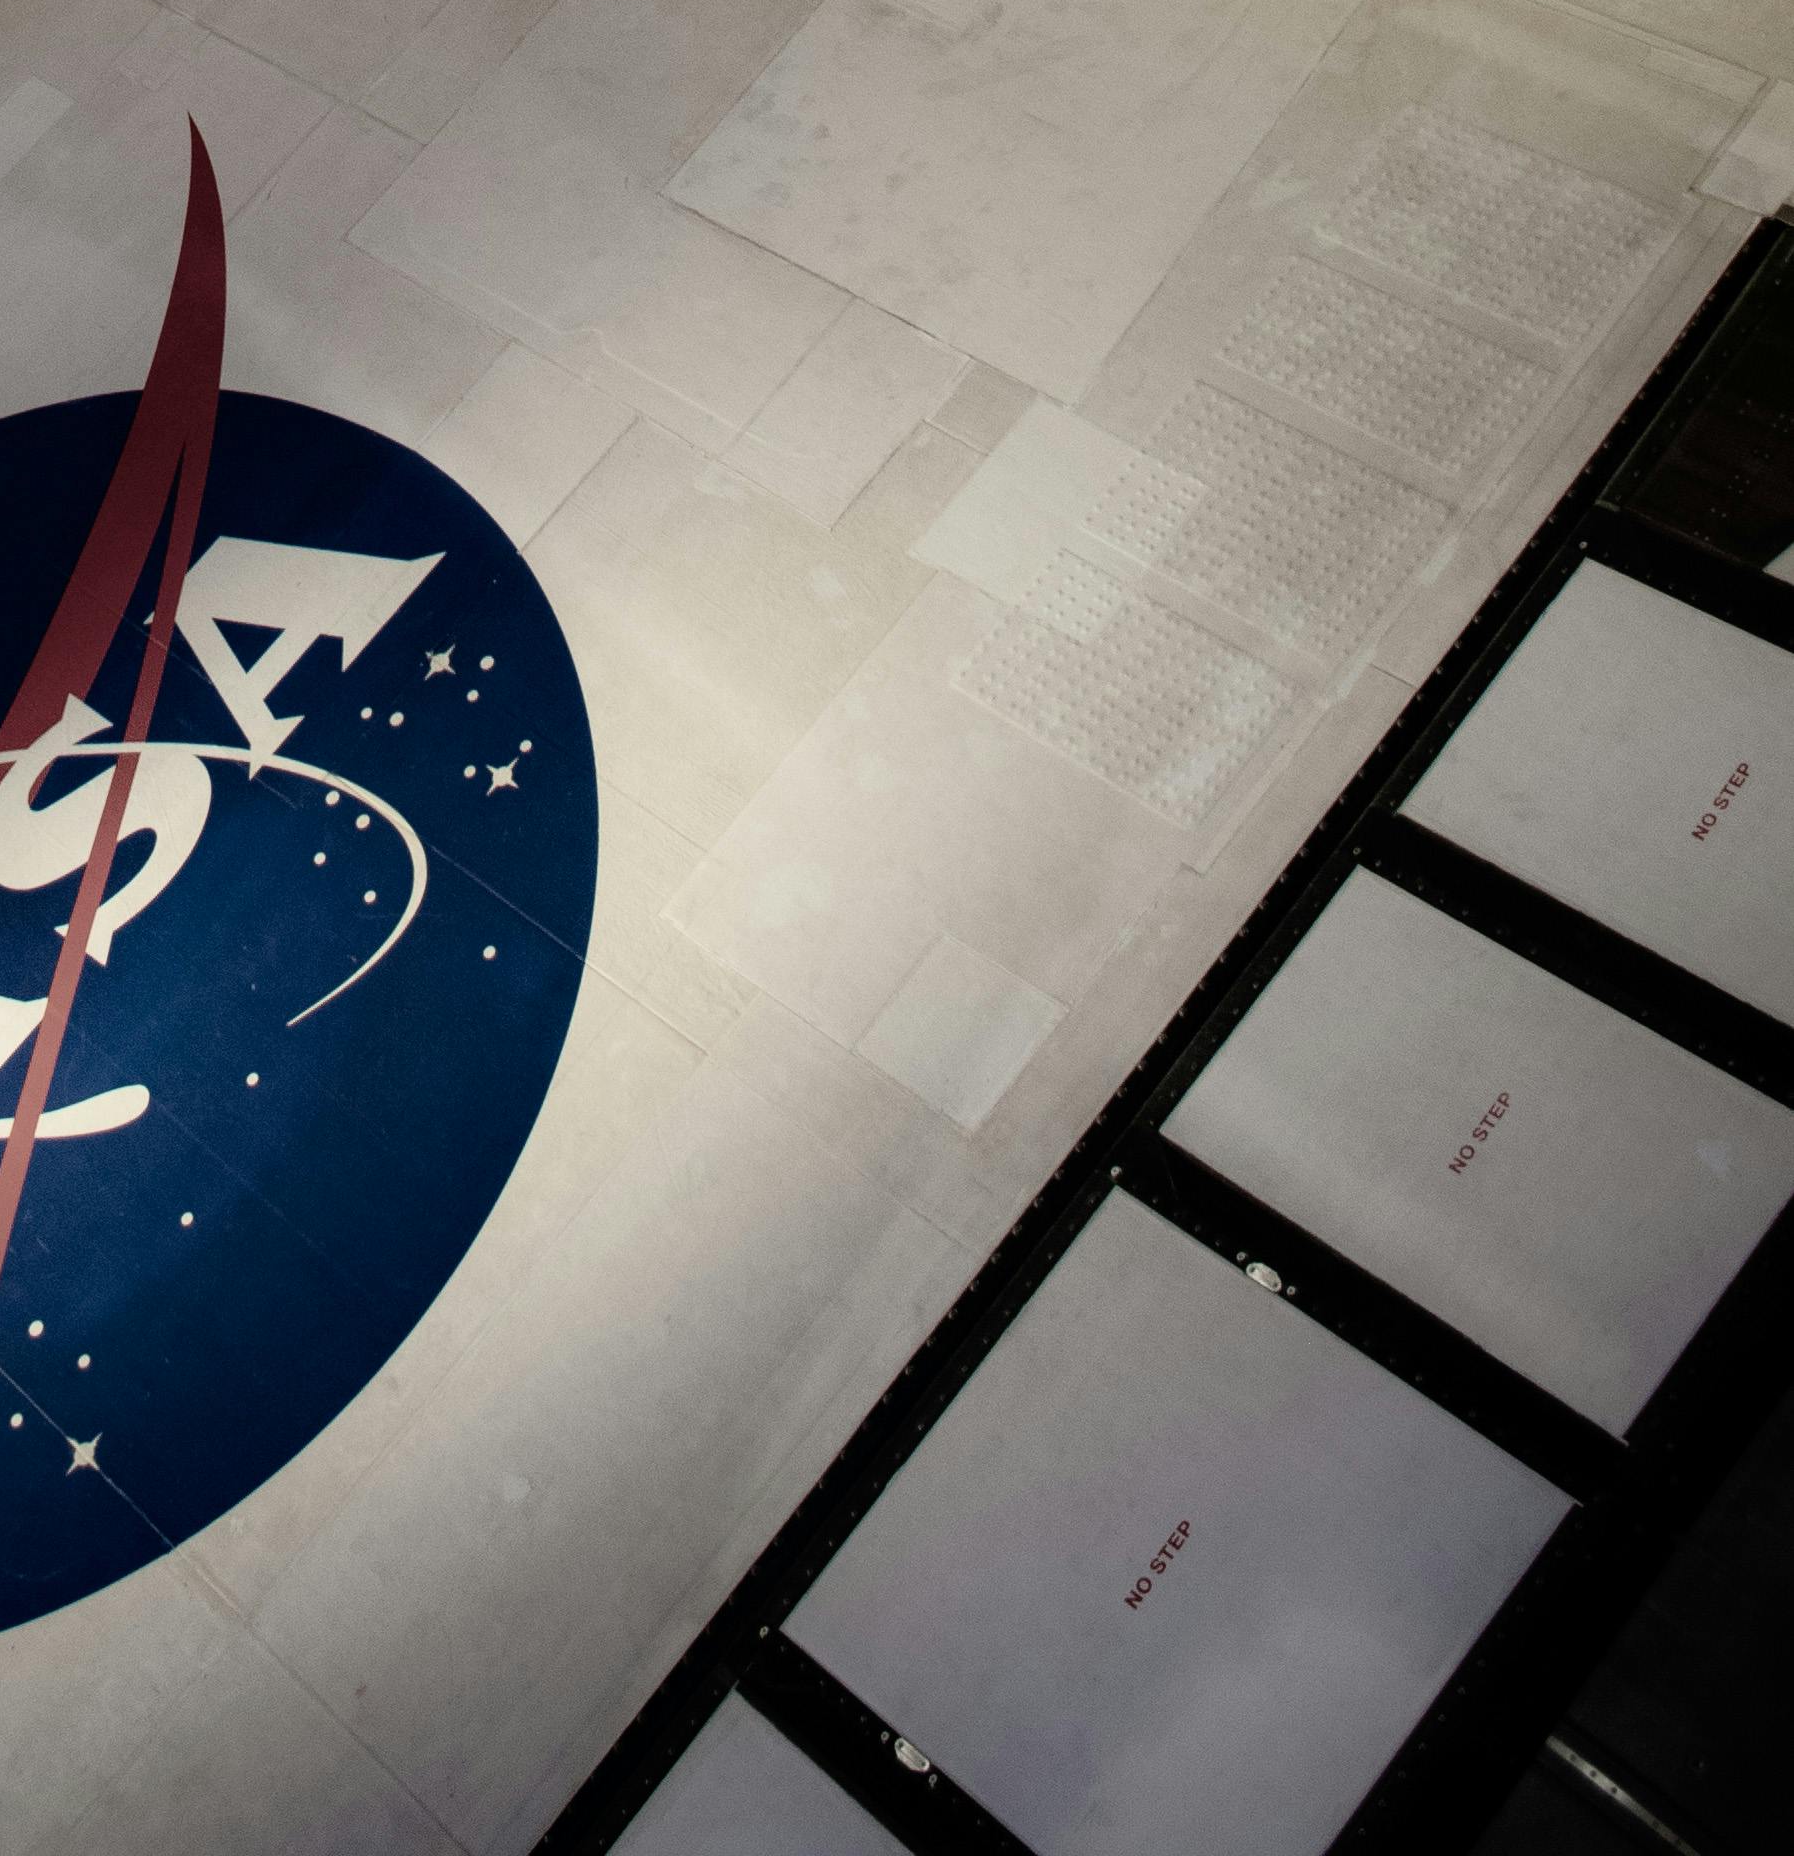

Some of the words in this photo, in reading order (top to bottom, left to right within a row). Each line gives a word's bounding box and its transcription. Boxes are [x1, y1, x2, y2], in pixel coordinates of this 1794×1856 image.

[1692, 813, 1717, 841] NO
[1713, 762, 1749, 810] STEP
[1449, 1145, 1475, 1174] NO
[1472, 1092, 1510, 1142] STEP
[1124, 1576, 1152, 1610] NO
[1149, 1520, 1191, 1574] STEP
